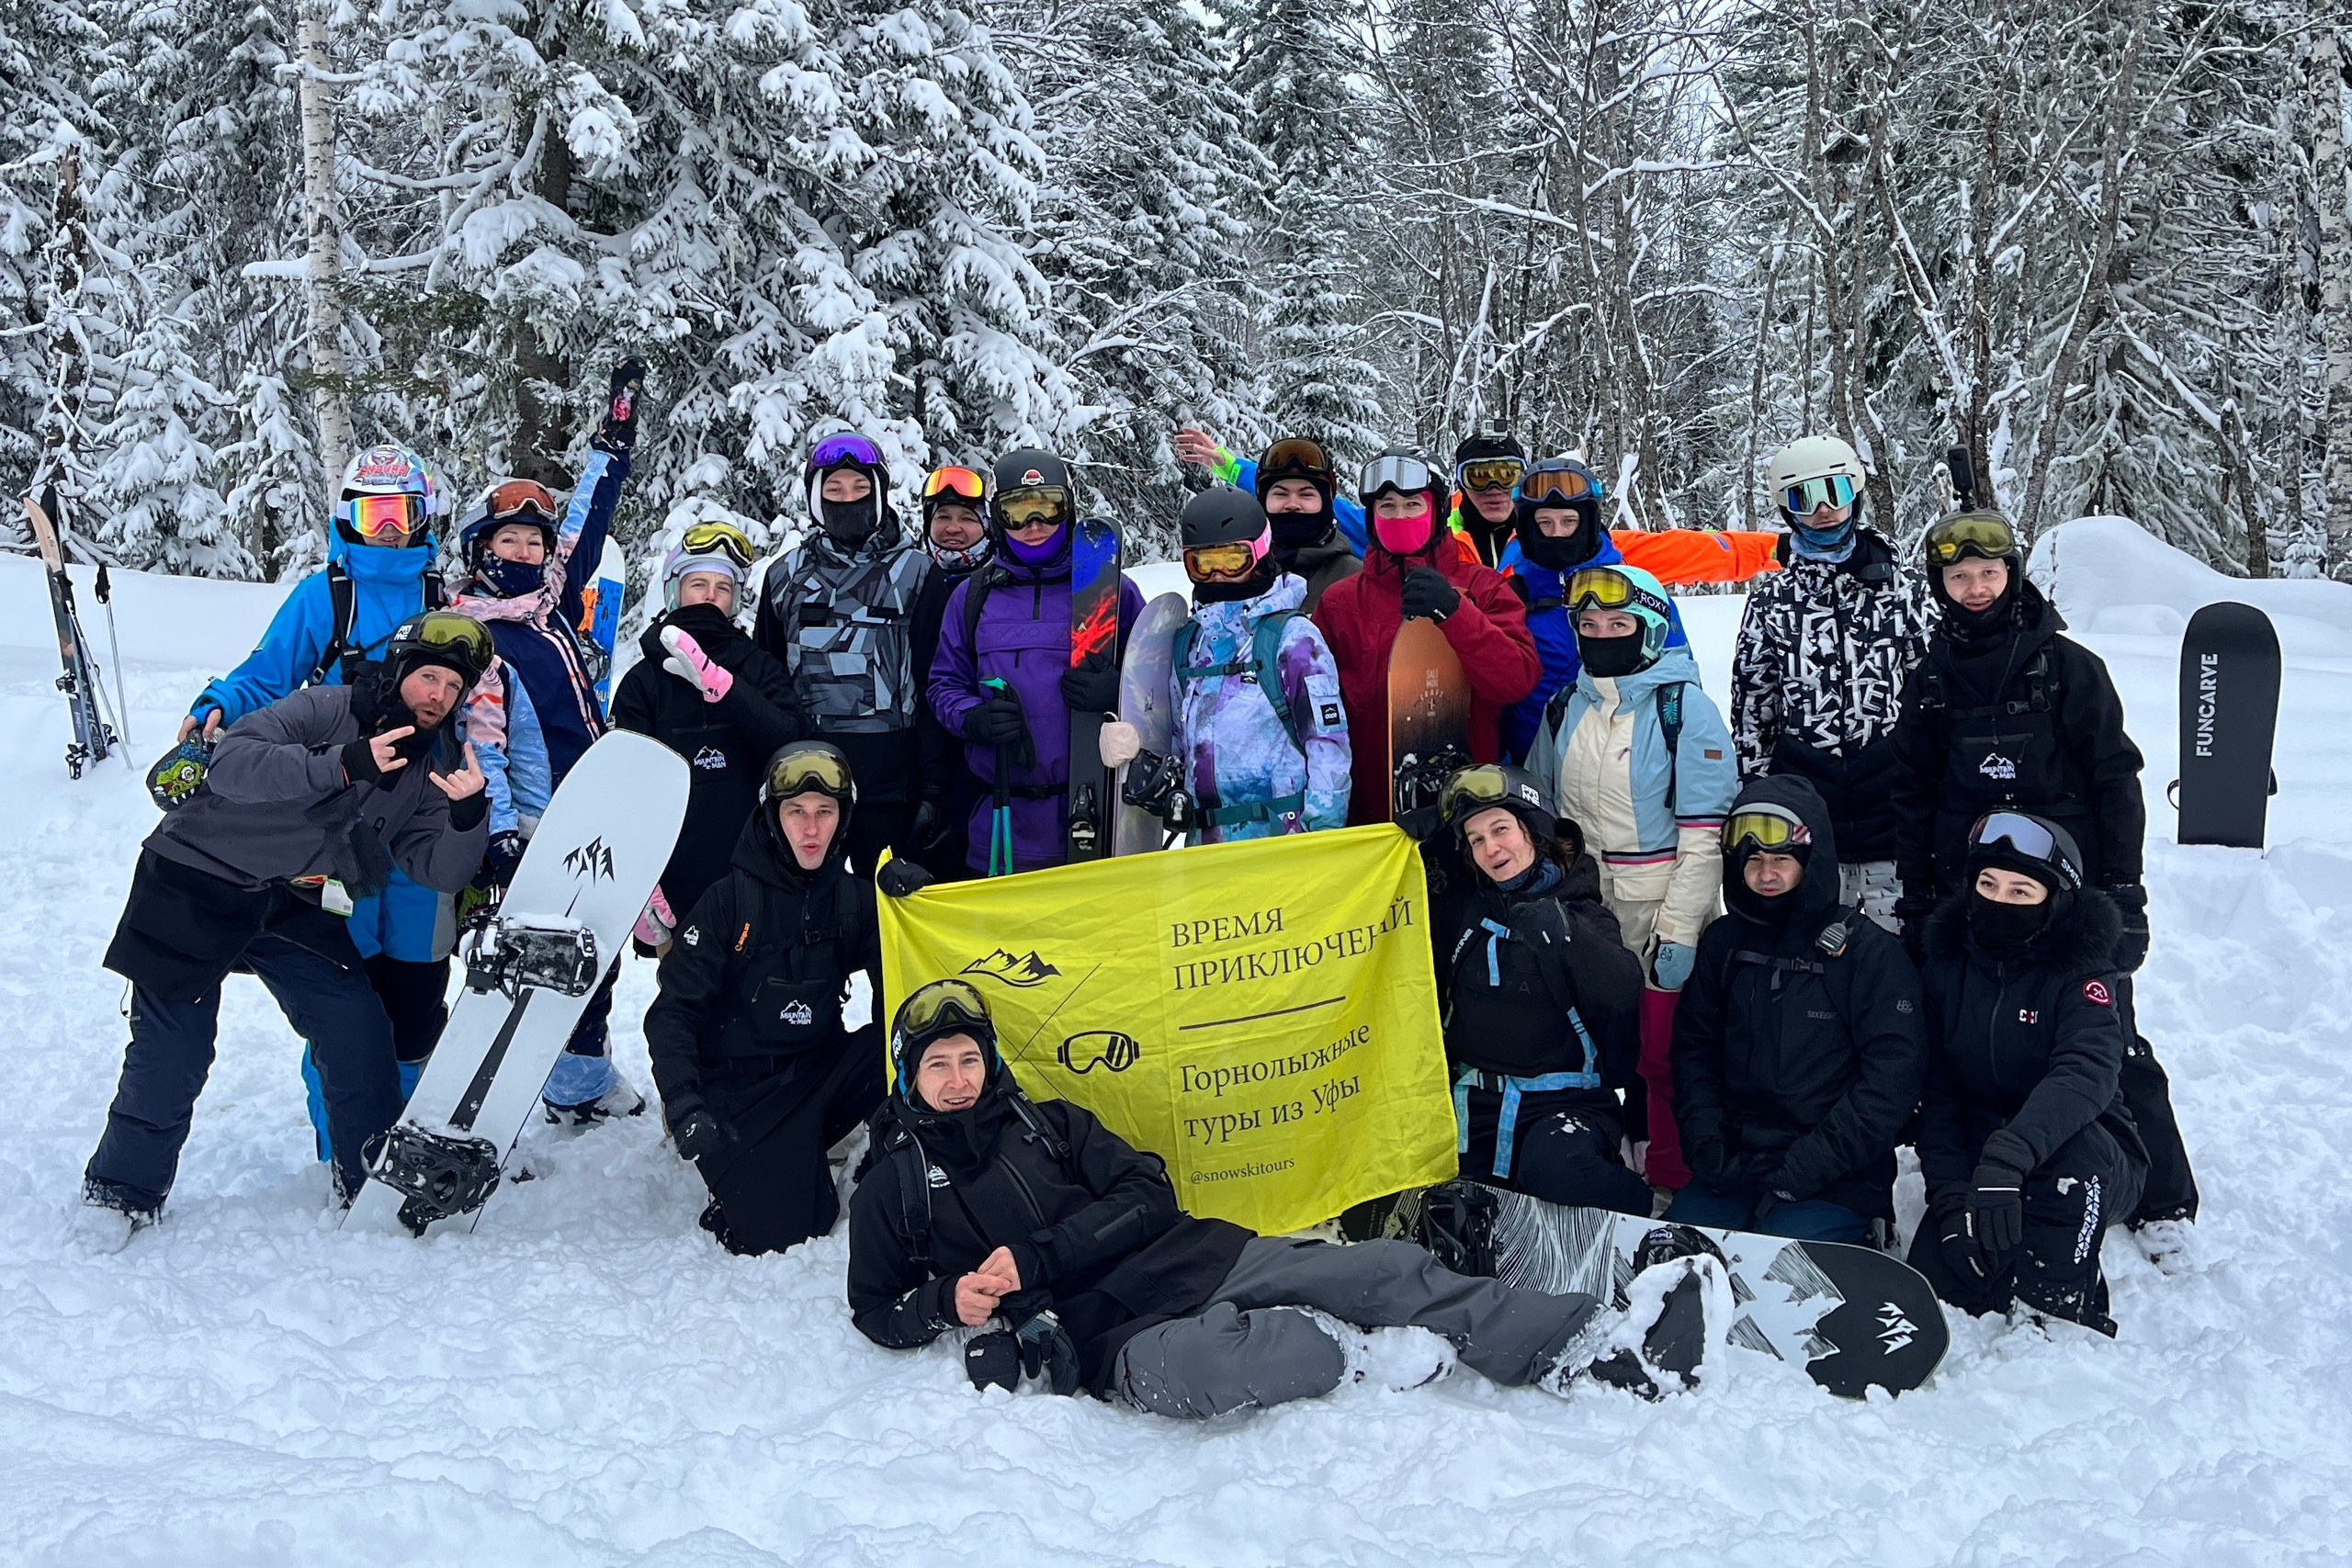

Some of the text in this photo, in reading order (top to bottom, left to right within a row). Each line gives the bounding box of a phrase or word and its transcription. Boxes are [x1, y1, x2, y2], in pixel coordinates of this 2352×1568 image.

[1640, 592, 1667, 614] ROXY
[2196, 653, 2218, 757] FUNCARVE
[2061, 858, 2082, 889] SMITH
[1171, 907, 1284, 948] ВРЕМЯ
[1452, 928, 1474, 964] DAKINE
[1180, 1024, 1371, 1098] Горнолыжные
[1183, 1075, 1362, 1145] туры из Уфы
[1190, 1157, 1295, 1185] @snowskitours
